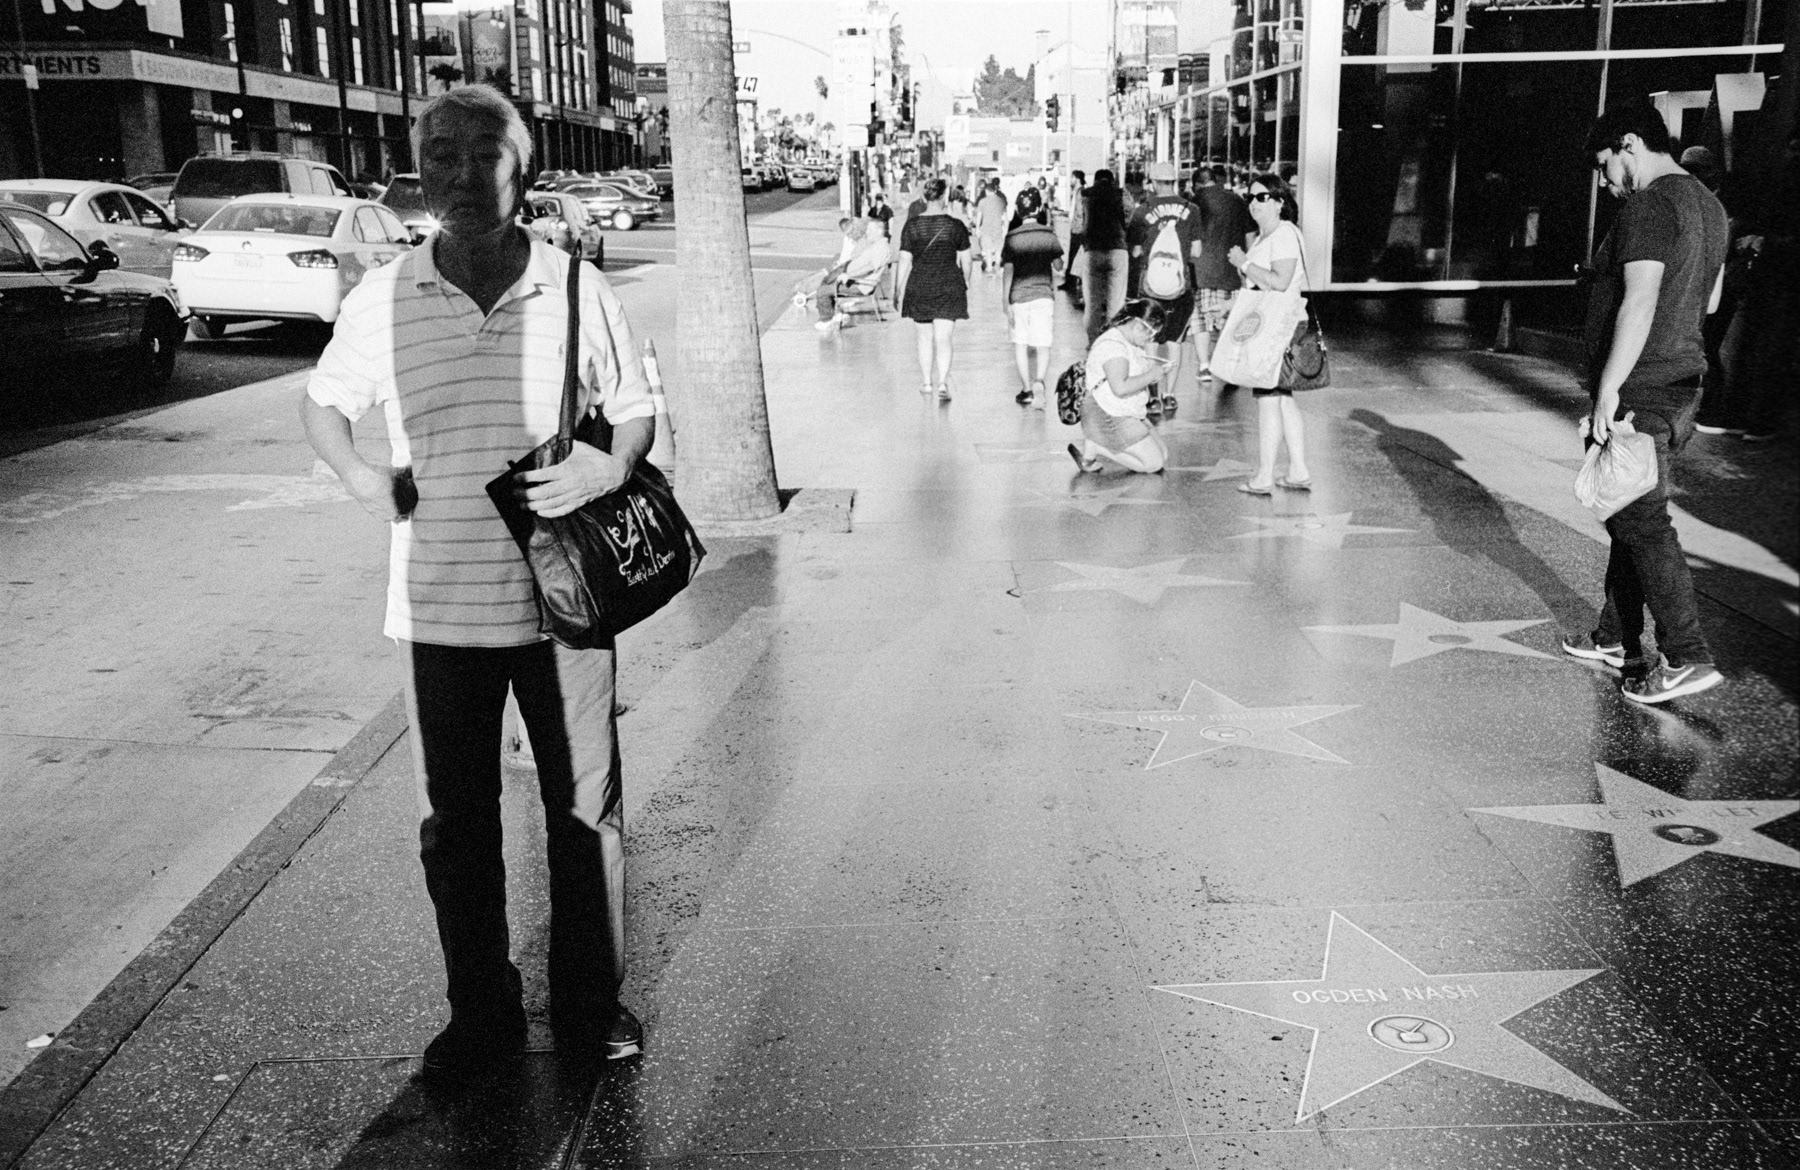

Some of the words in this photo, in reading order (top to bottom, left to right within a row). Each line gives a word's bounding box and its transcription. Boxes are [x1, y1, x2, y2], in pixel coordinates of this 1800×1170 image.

[838, 55, 866, 65] MUST
[743, 77, 758, 92] 47
[1137, 713, 1198, 723] PEGGY
[1292, 988, 1389, 1004] OGDEN
[1401, 984, 1480, 1001] NASH
